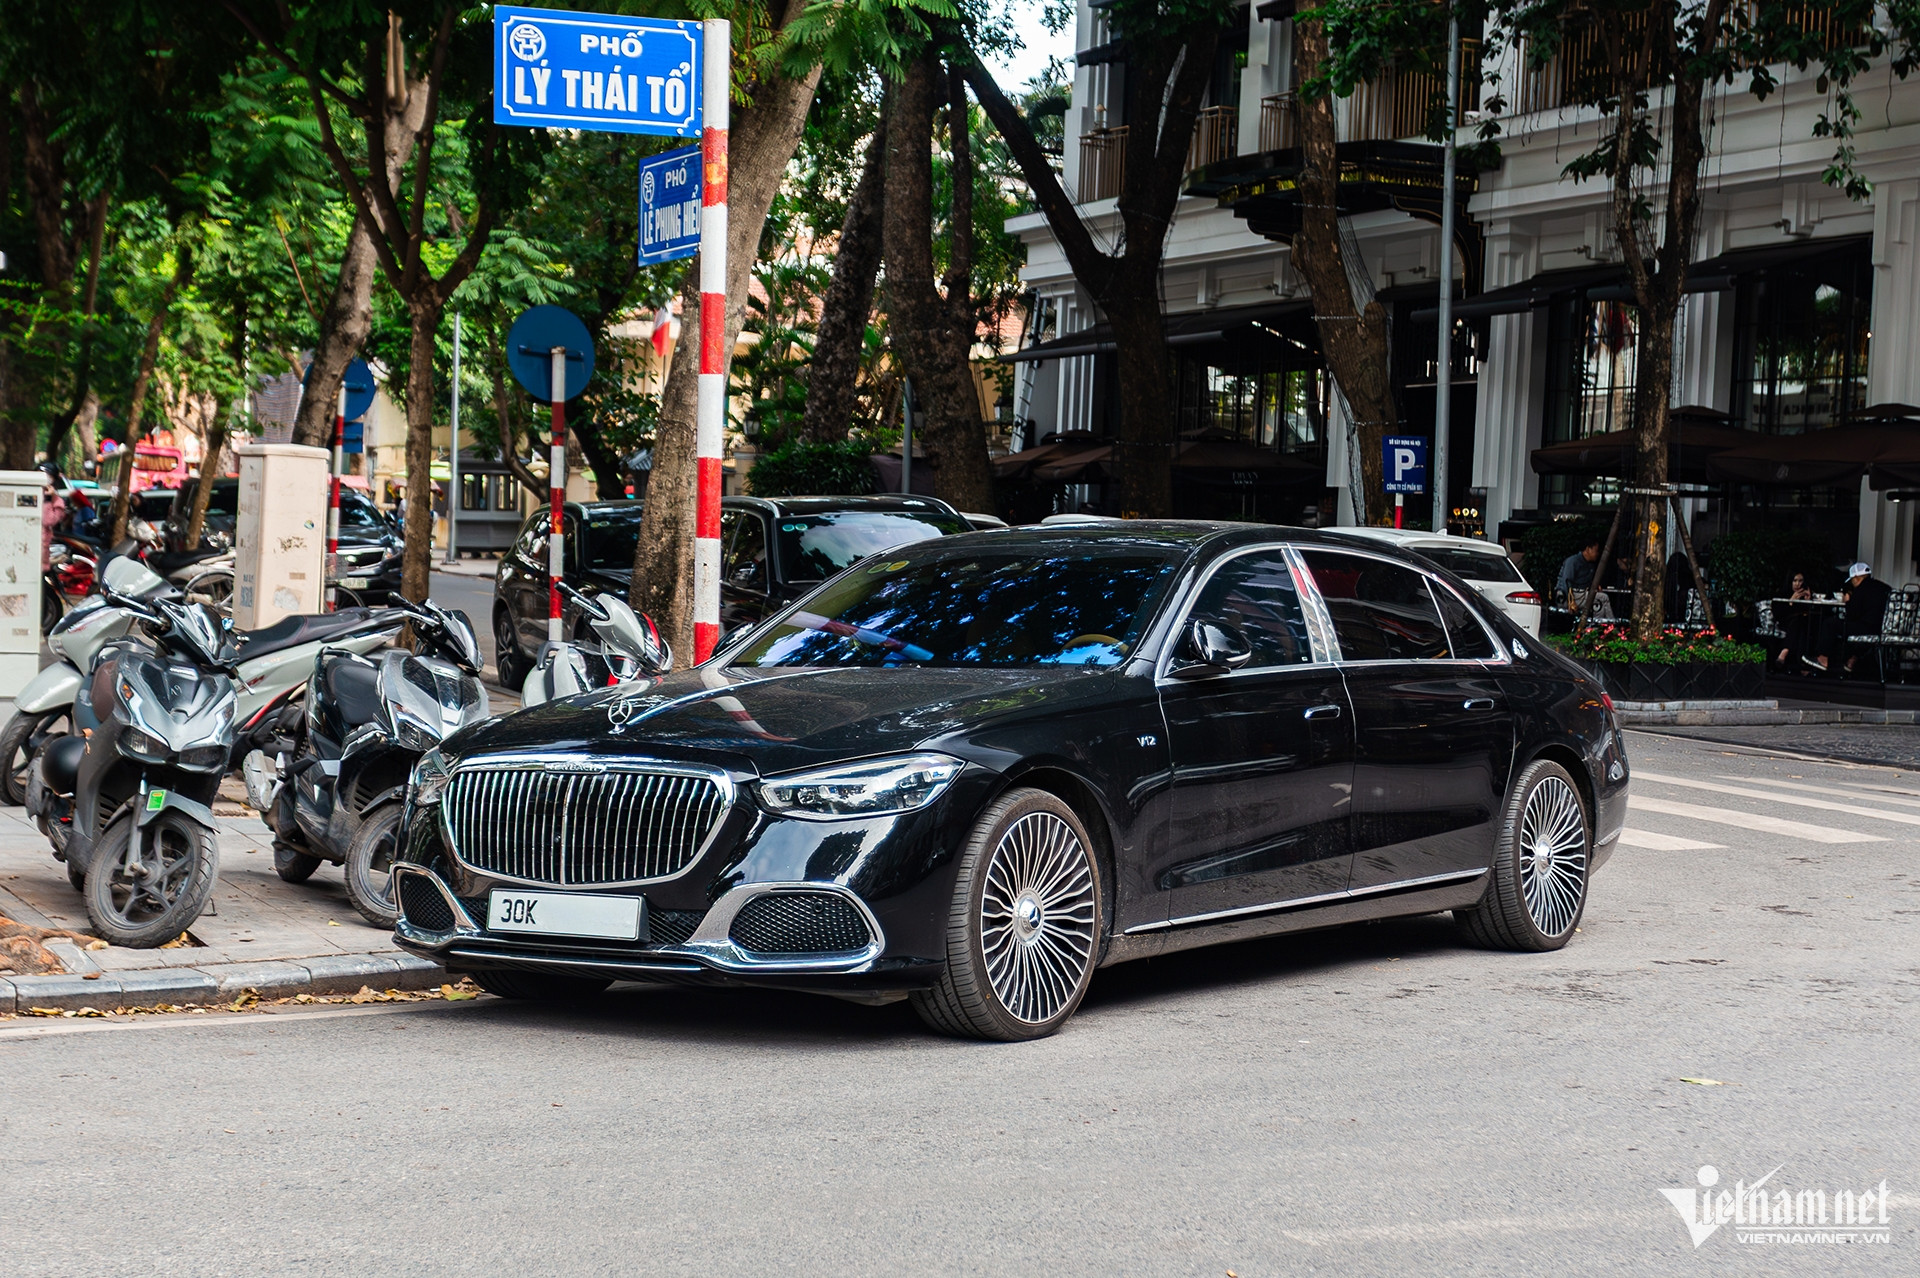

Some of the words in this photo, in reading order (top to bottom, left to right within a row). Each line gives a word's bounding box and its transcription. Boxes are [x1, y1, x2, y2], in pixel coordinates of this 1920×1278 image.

[580, 31, 645, 58] PHỐ
[514, 59, 552, 106] LÝ
[562, 65, 638, 113] THÁI
[646, 62, 691, 116] TỔ
[665, 159, 688, 189] PHỐ
[644, 203, 654, 246] LÊ
[655, 203, 681, 249] PHỤNG
[1395, 448, 1415, 481] P
[1136, 735, 1157, 748] V12
[501, 899, 538, 924] 30K
